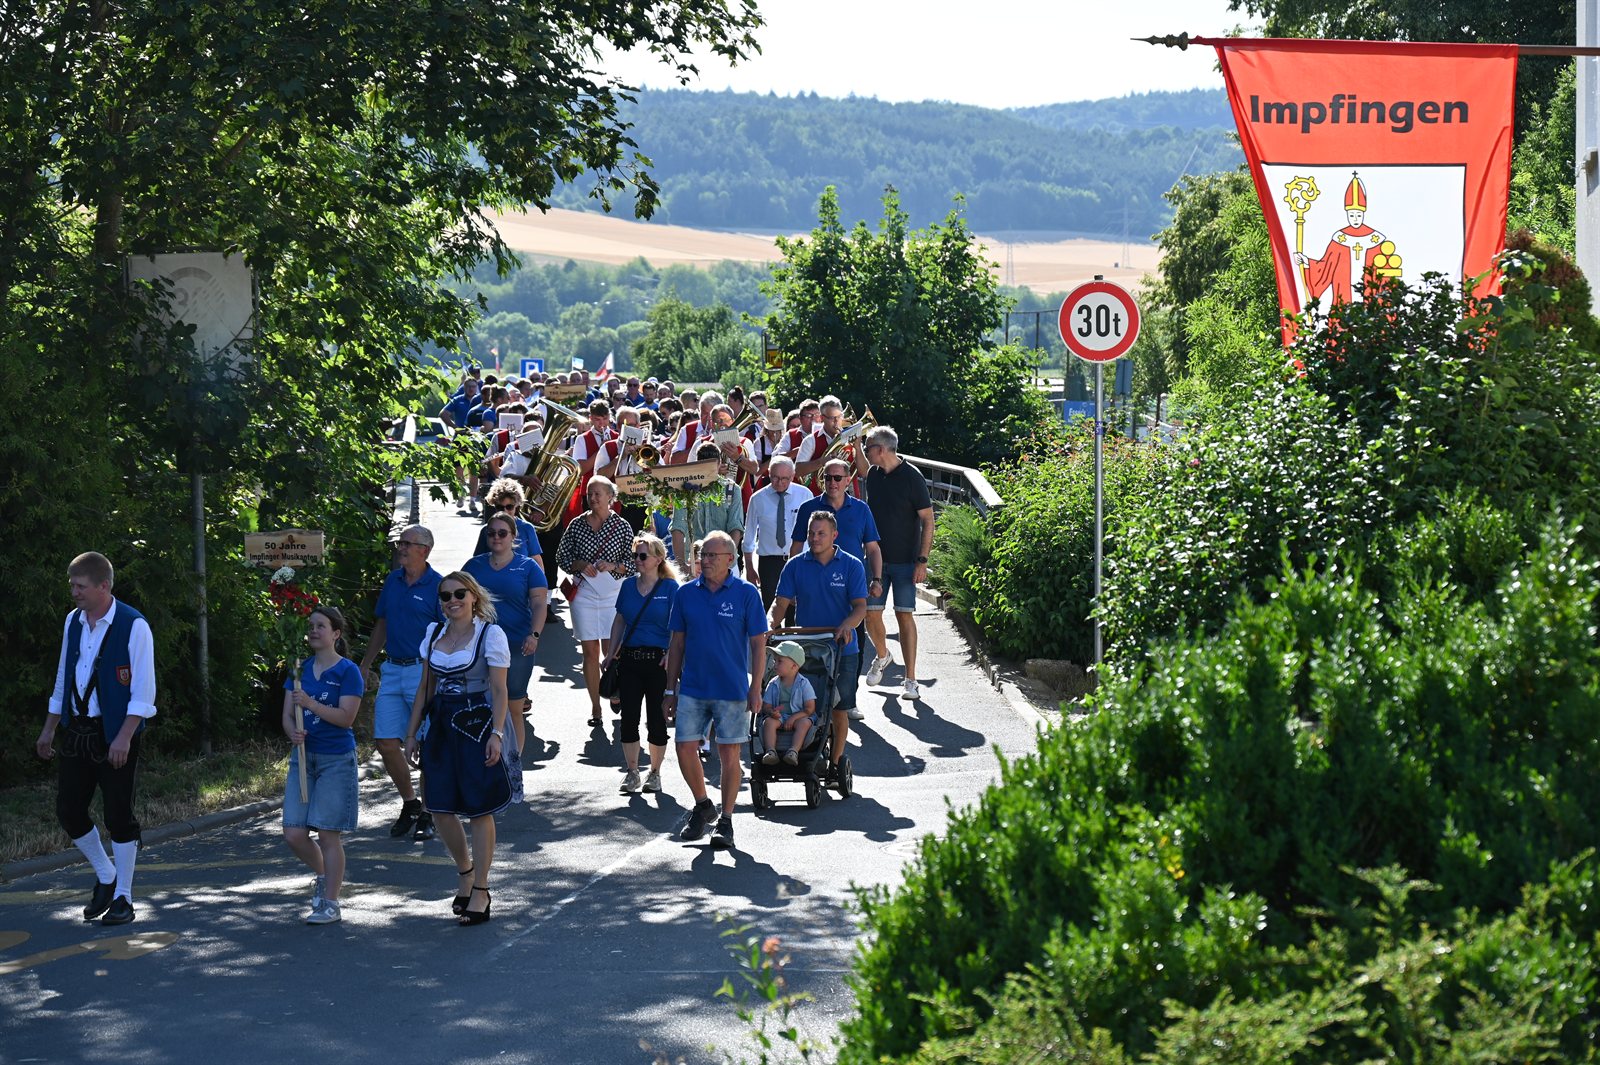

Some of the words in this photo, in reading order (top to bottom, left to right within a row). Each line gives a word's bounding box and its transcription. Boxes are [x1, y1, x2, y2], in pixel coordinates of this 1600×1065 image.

[1250, 94, 1469, 134] Impfingen
[265, 542, 276, 550] 50
[279, 542, 306, 550] Jahre
[249, 553, 279, 561] Impfinger
[281, 553, 318, 561] Musikanten
